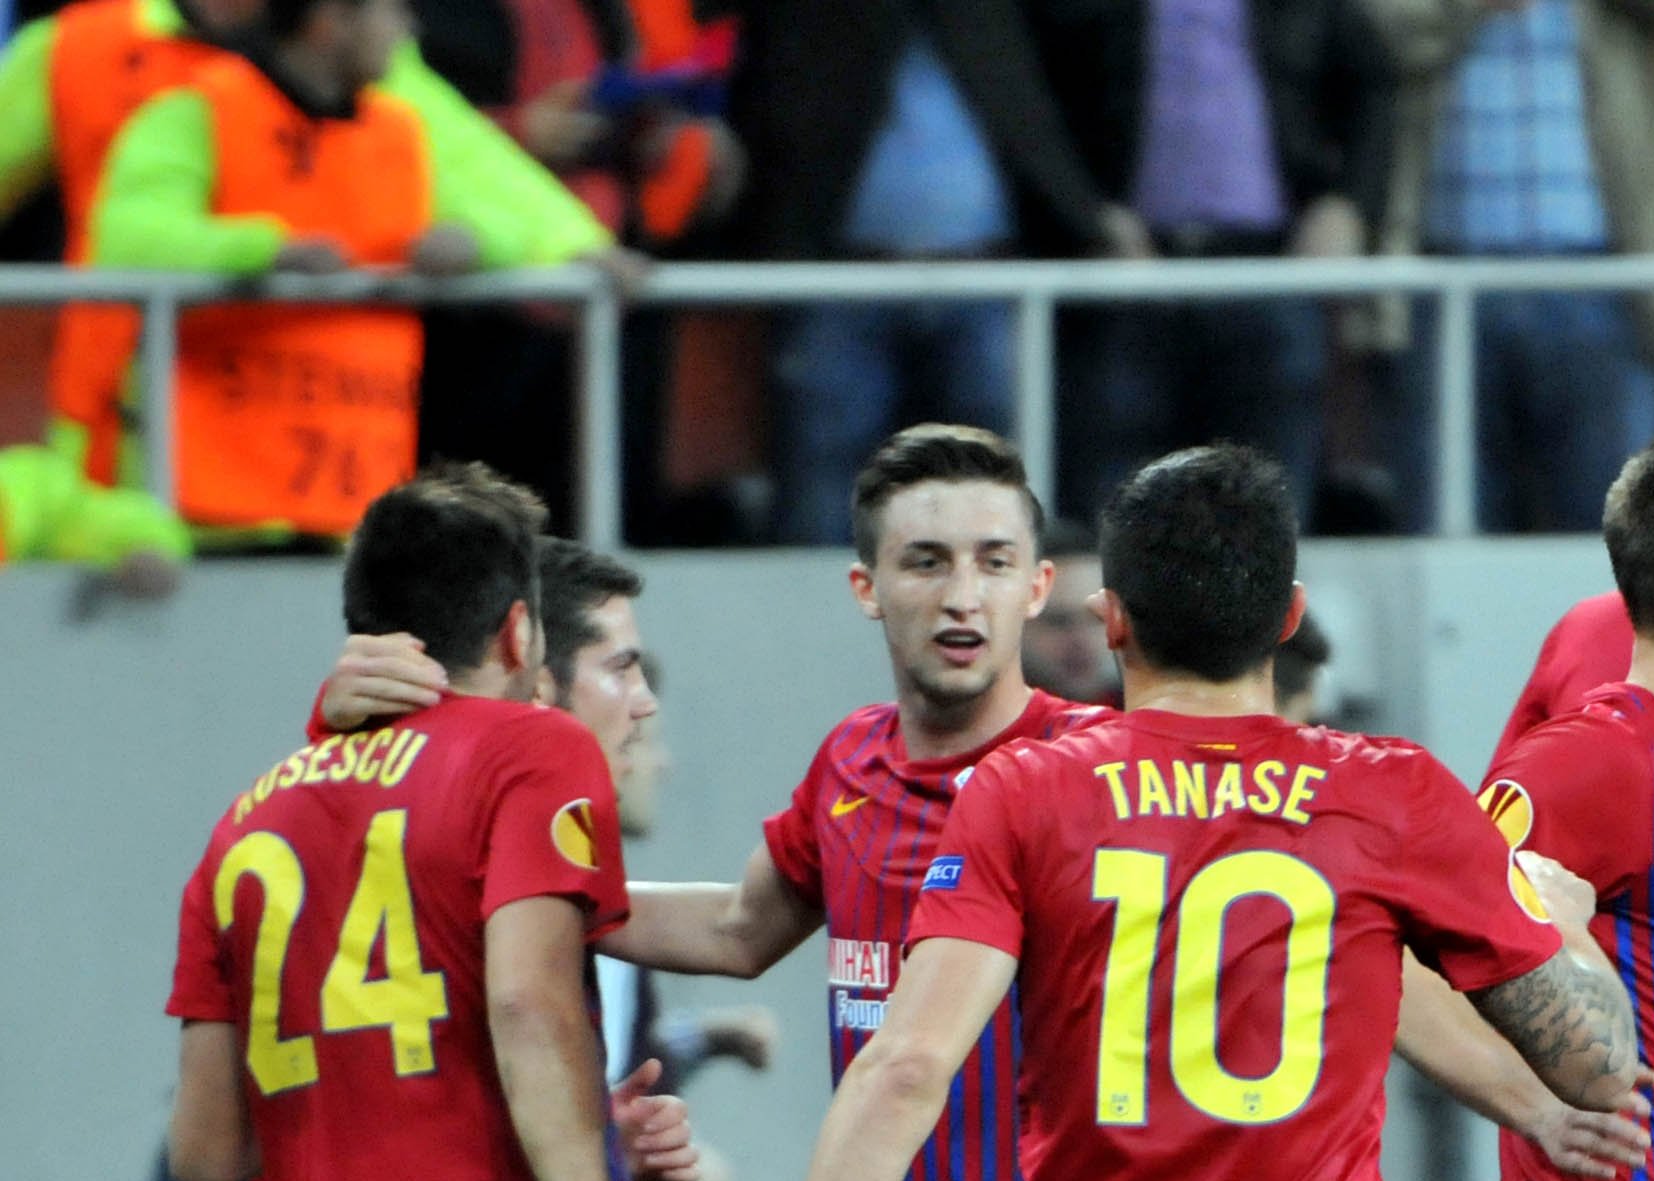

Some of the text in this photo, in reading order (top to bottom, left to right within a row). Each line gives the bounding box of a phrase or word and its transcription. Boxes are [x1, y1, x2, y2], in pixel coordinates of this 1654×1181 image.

[1094, 759, 1328, 825] TANASE
[214, 809, 449, 1096] 24
[1092, 847, 1336, 1126] 10
